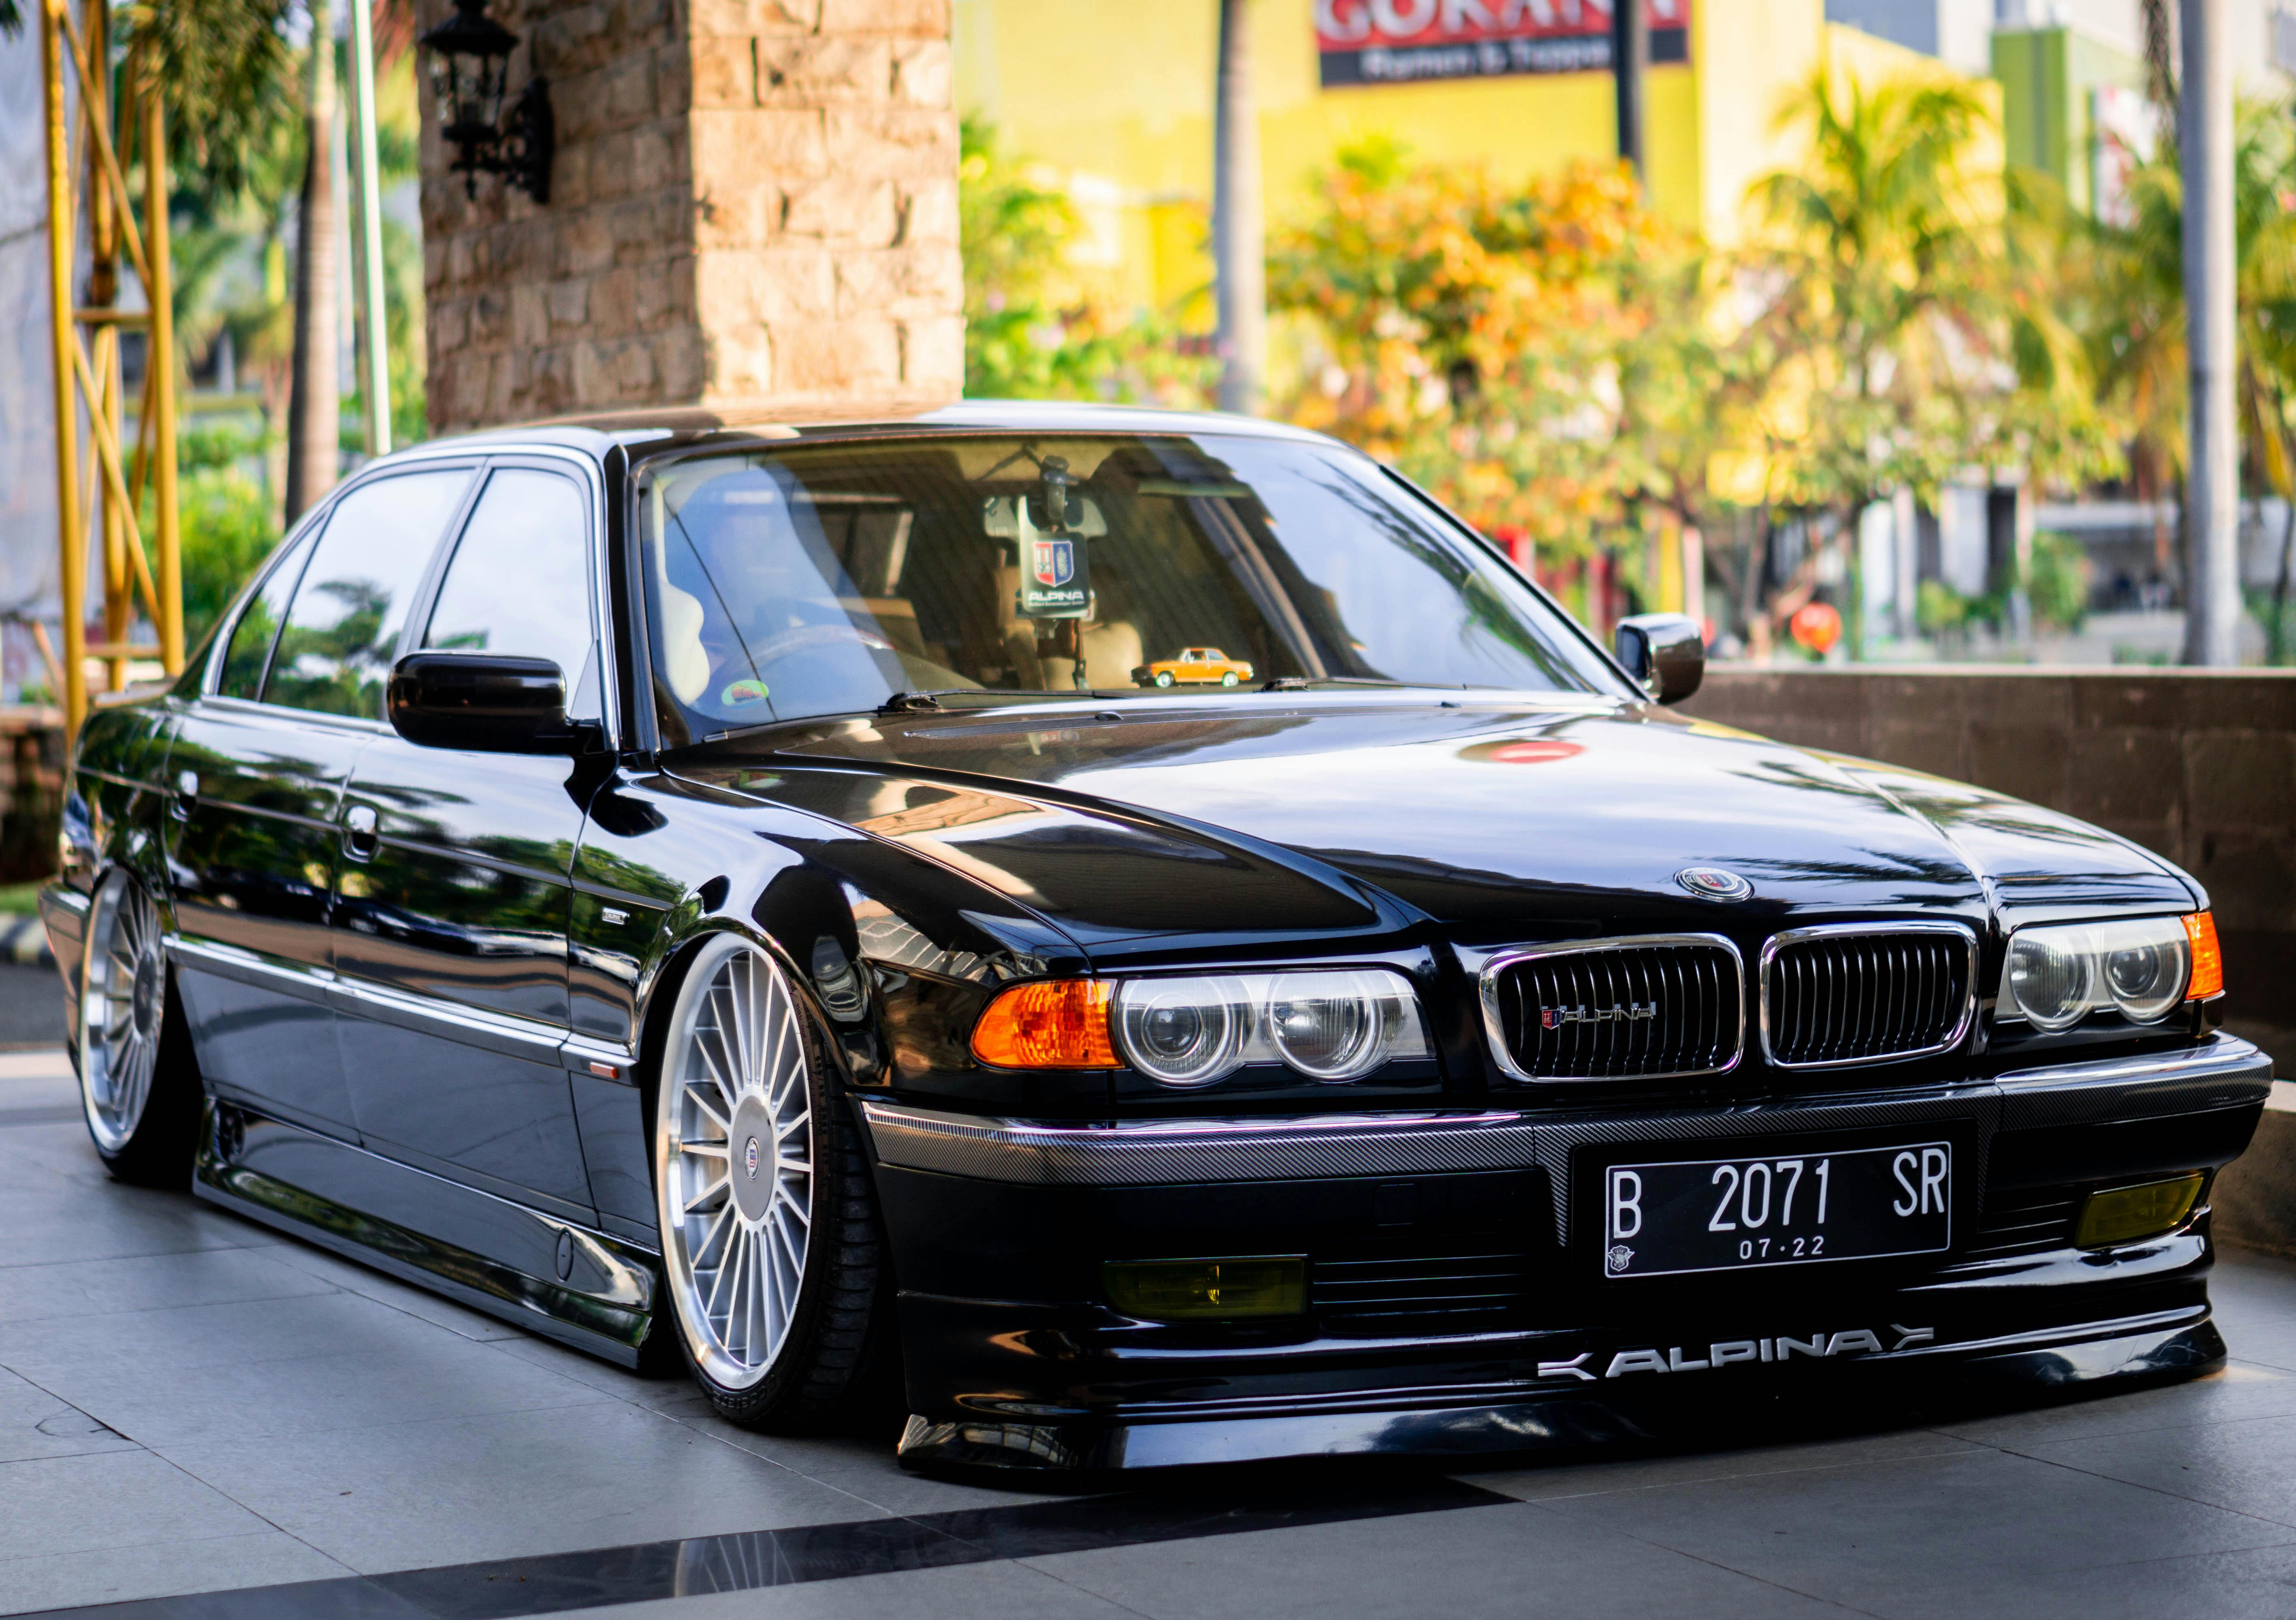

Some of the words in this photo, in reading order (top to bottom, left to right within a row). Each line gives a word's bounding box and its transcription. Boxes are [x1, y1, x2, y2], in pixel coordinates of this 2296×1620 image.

[1028, 590, 1084, 601] ALPINA
[1613, 1170, 1642, 1238] B
[1708, 1159, 1829, 1232] 2071
[1893, 1148, 1946, 1217] SR
[1605, 1328, 1884, 1378] ALPINA
